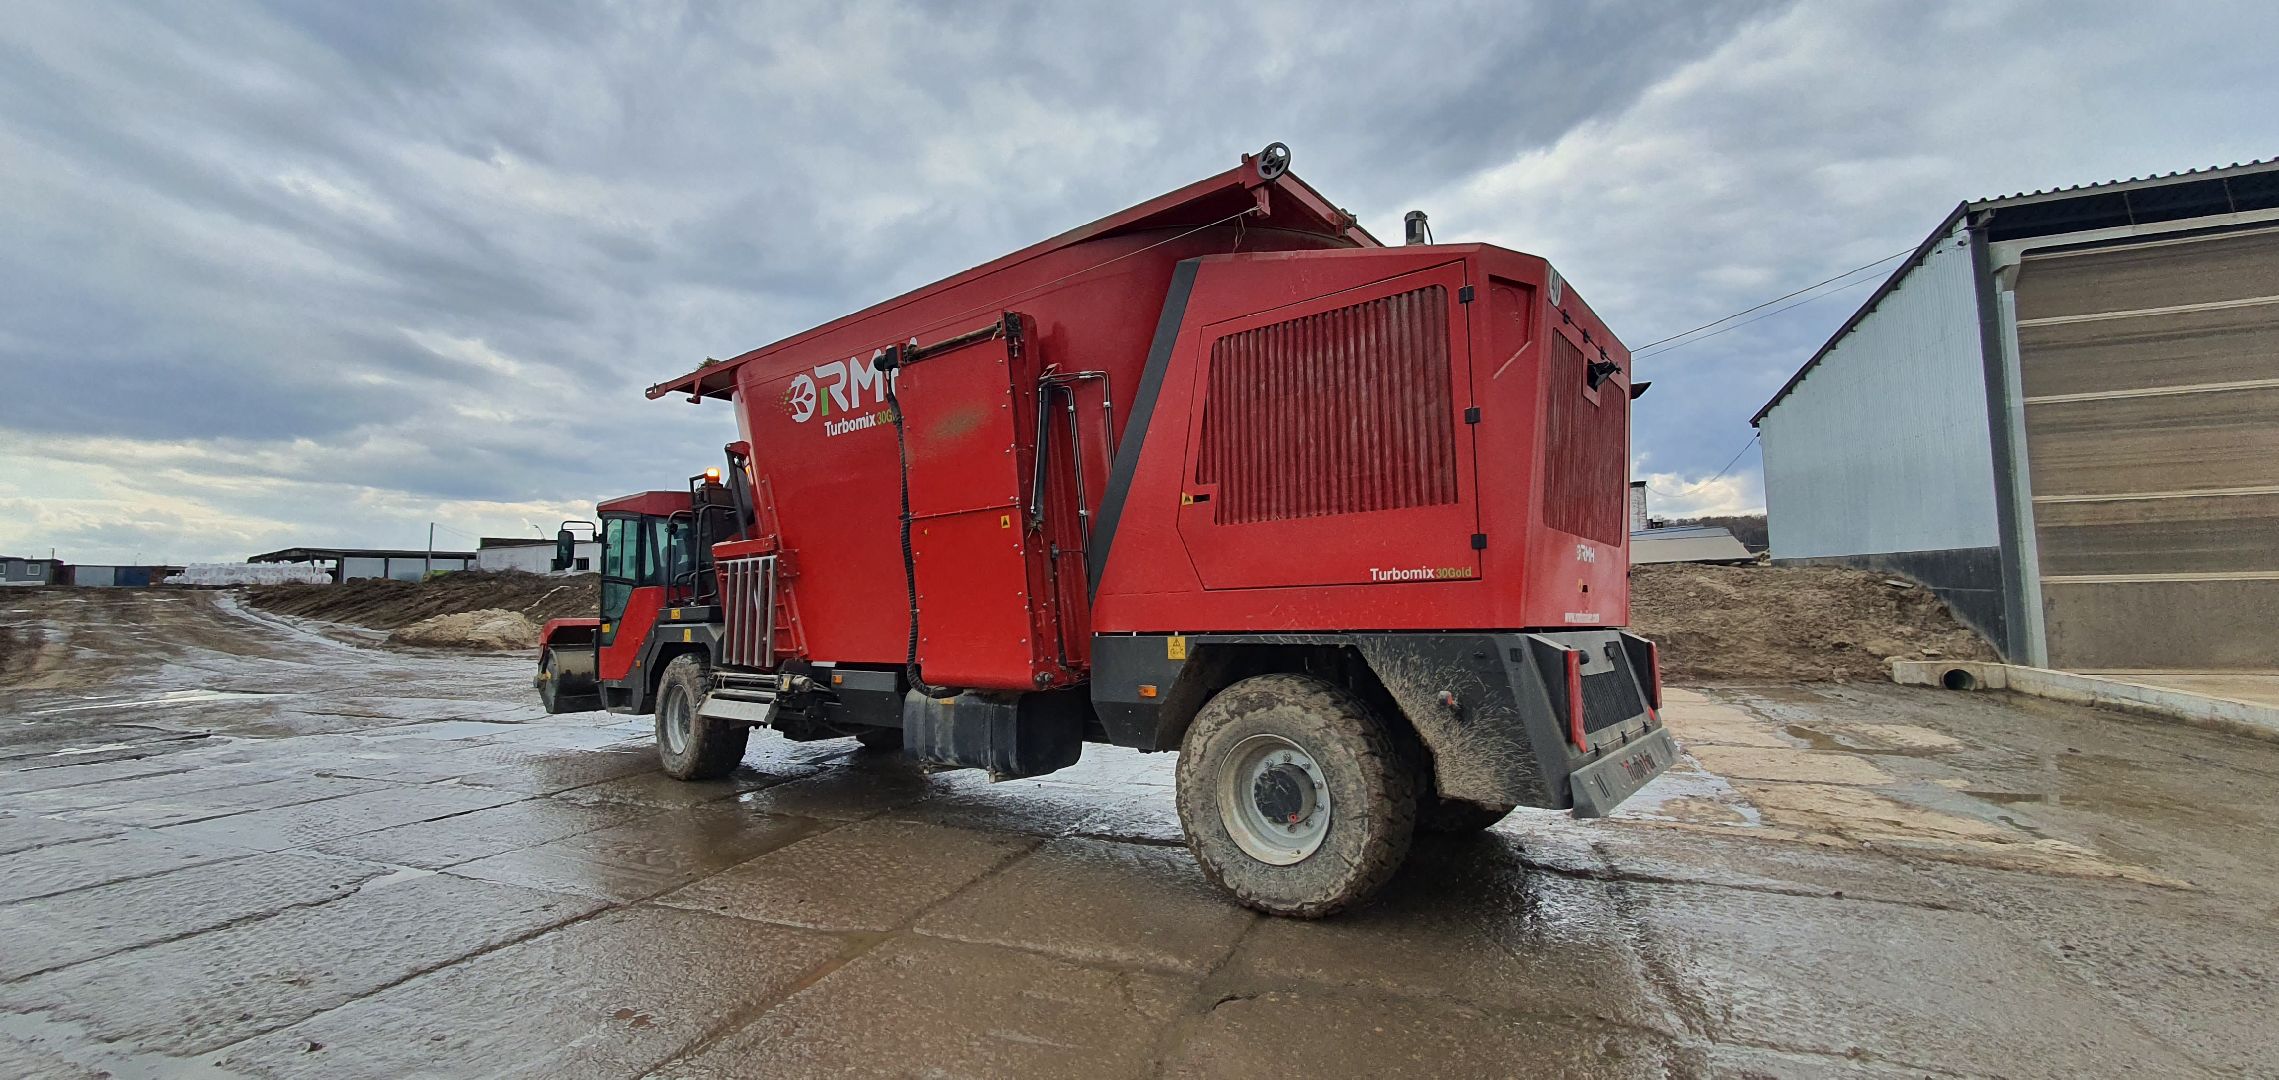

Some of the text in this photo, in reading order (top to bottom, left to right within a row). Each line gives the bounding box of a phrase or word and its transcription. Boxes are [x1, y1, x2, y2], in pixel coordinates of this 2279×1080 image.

[824, 411, 877, 437] Turbomix
[1369, 565, 1472, 581] Turbomix 30Gold
